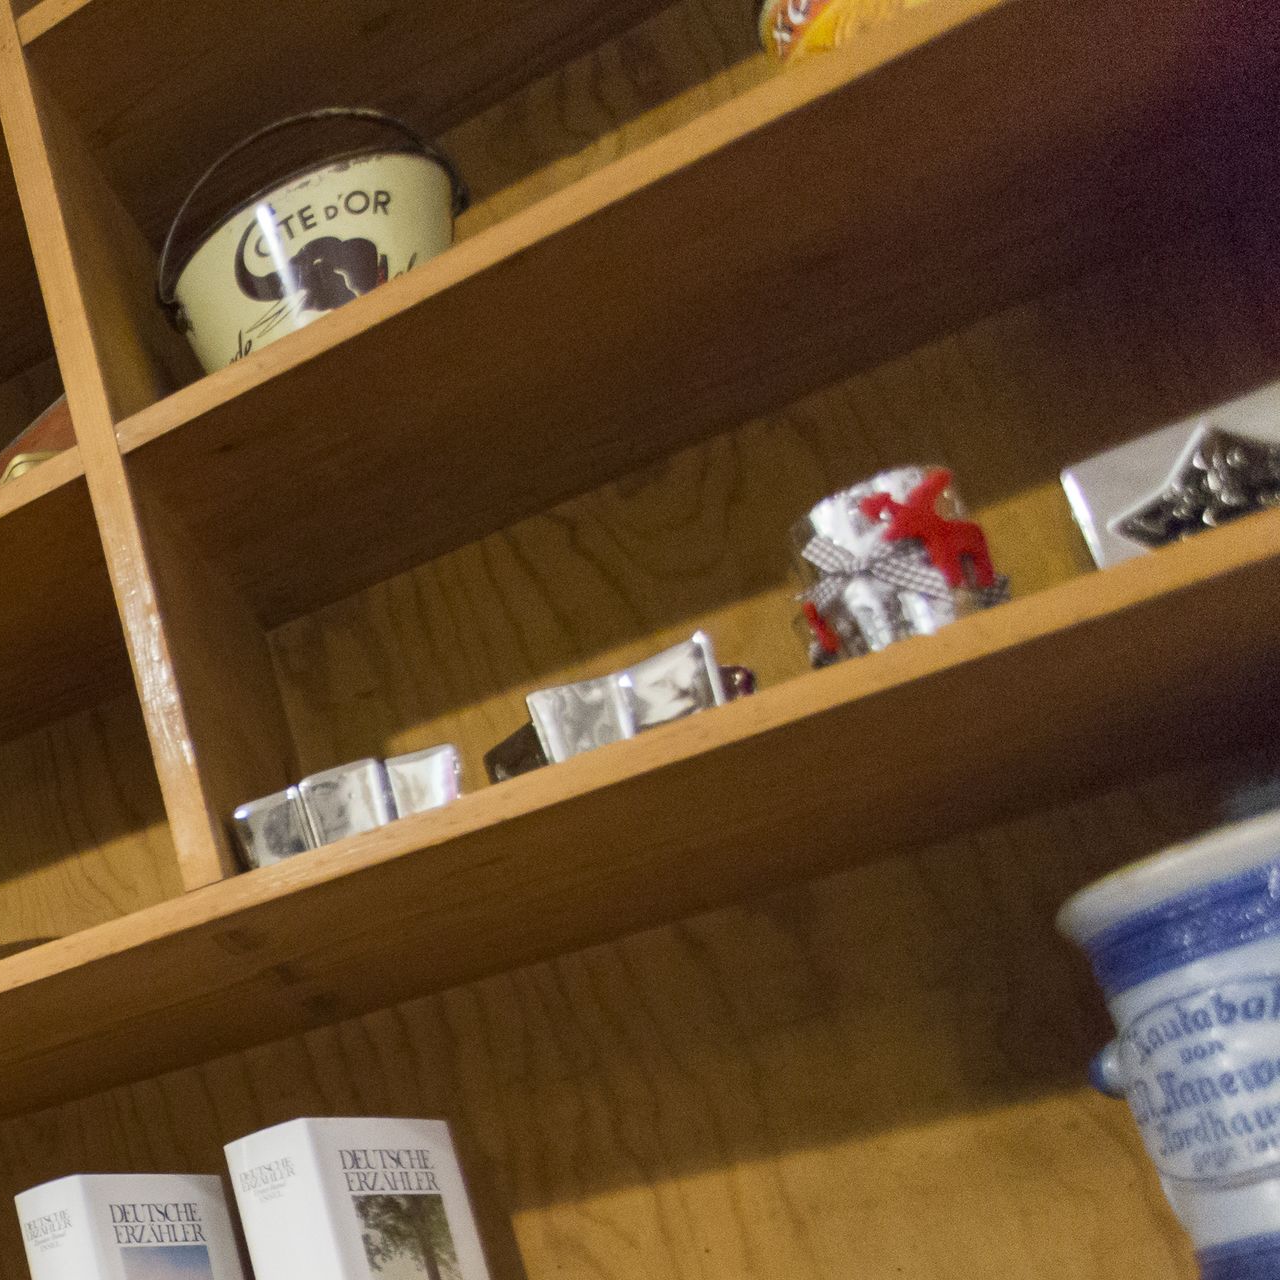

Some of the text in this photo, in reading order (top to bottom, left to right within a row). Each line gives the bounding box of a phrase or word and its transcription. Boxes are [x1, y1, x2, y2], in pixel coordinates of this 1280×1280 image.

[240, 1157, 294, 1182] DEUTSCHE
[338, 1150, 435, 1170] DEUTSCHE
[109, 1203, 202, 1223] DEUTSCHE
